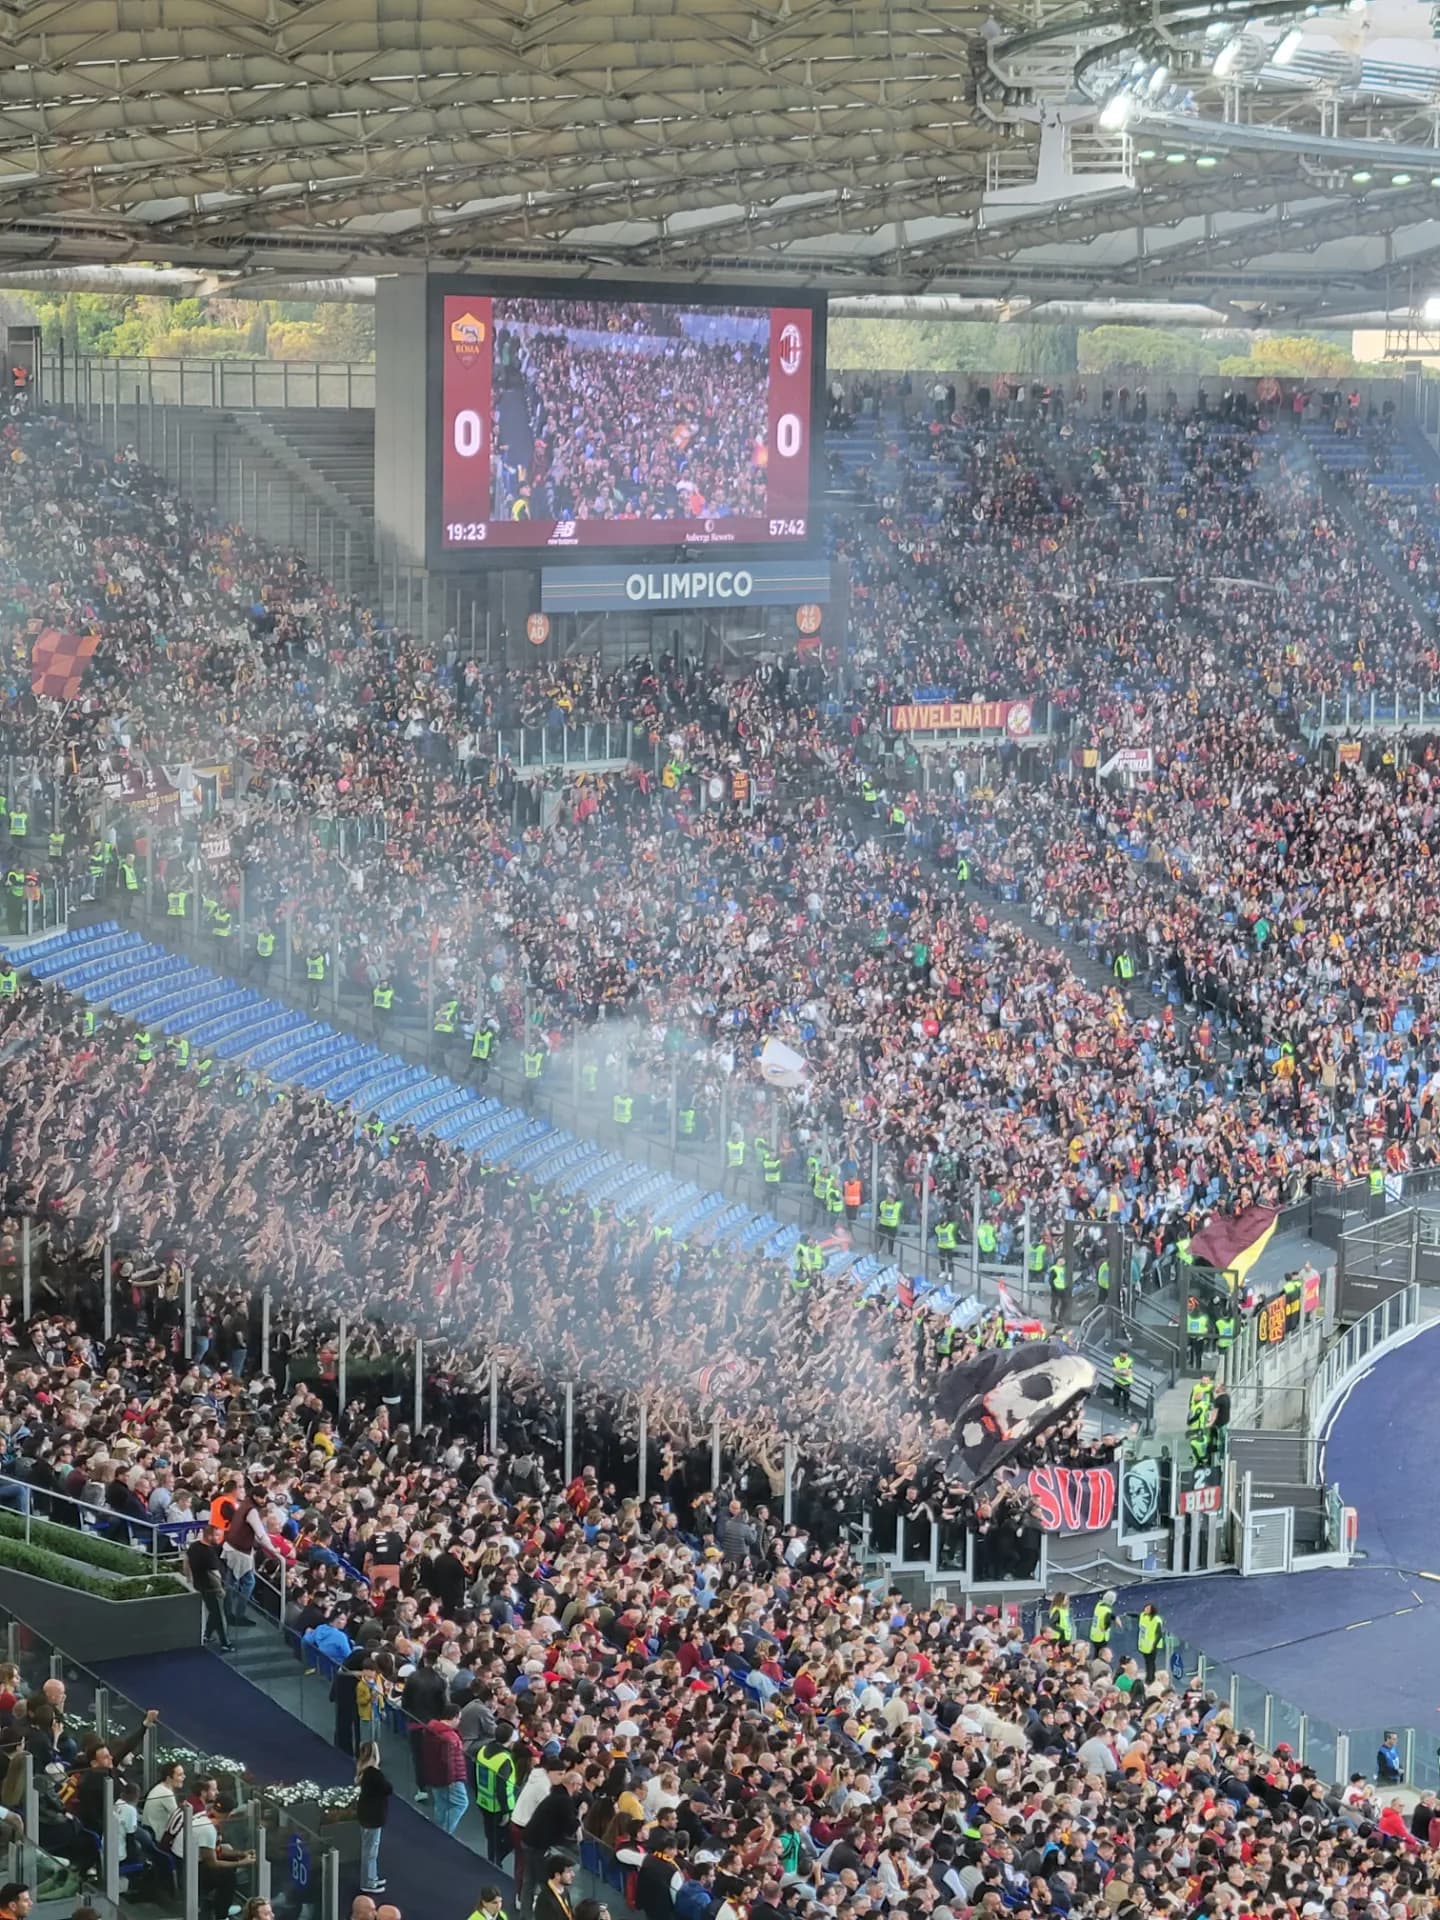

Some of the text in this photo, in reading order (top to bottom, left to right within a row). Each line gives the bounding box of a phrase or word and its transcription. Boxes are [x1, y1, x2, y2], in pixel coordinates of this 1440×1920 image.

[456, 343, 480, 353] ROMA
[454, 409, 481, 457] 0
[776, 413, 801, 457] 0
[446, 523, 487, 541] 19:23
[769, 519, 805, 536] 57:42
[626, 571, 753, 600] OLIMPICO
[530, 627, 545, 640] AD
[895, 703, 1001, 729] AVVELENATI
[1185, 1487, 1216, 1512] BLU
